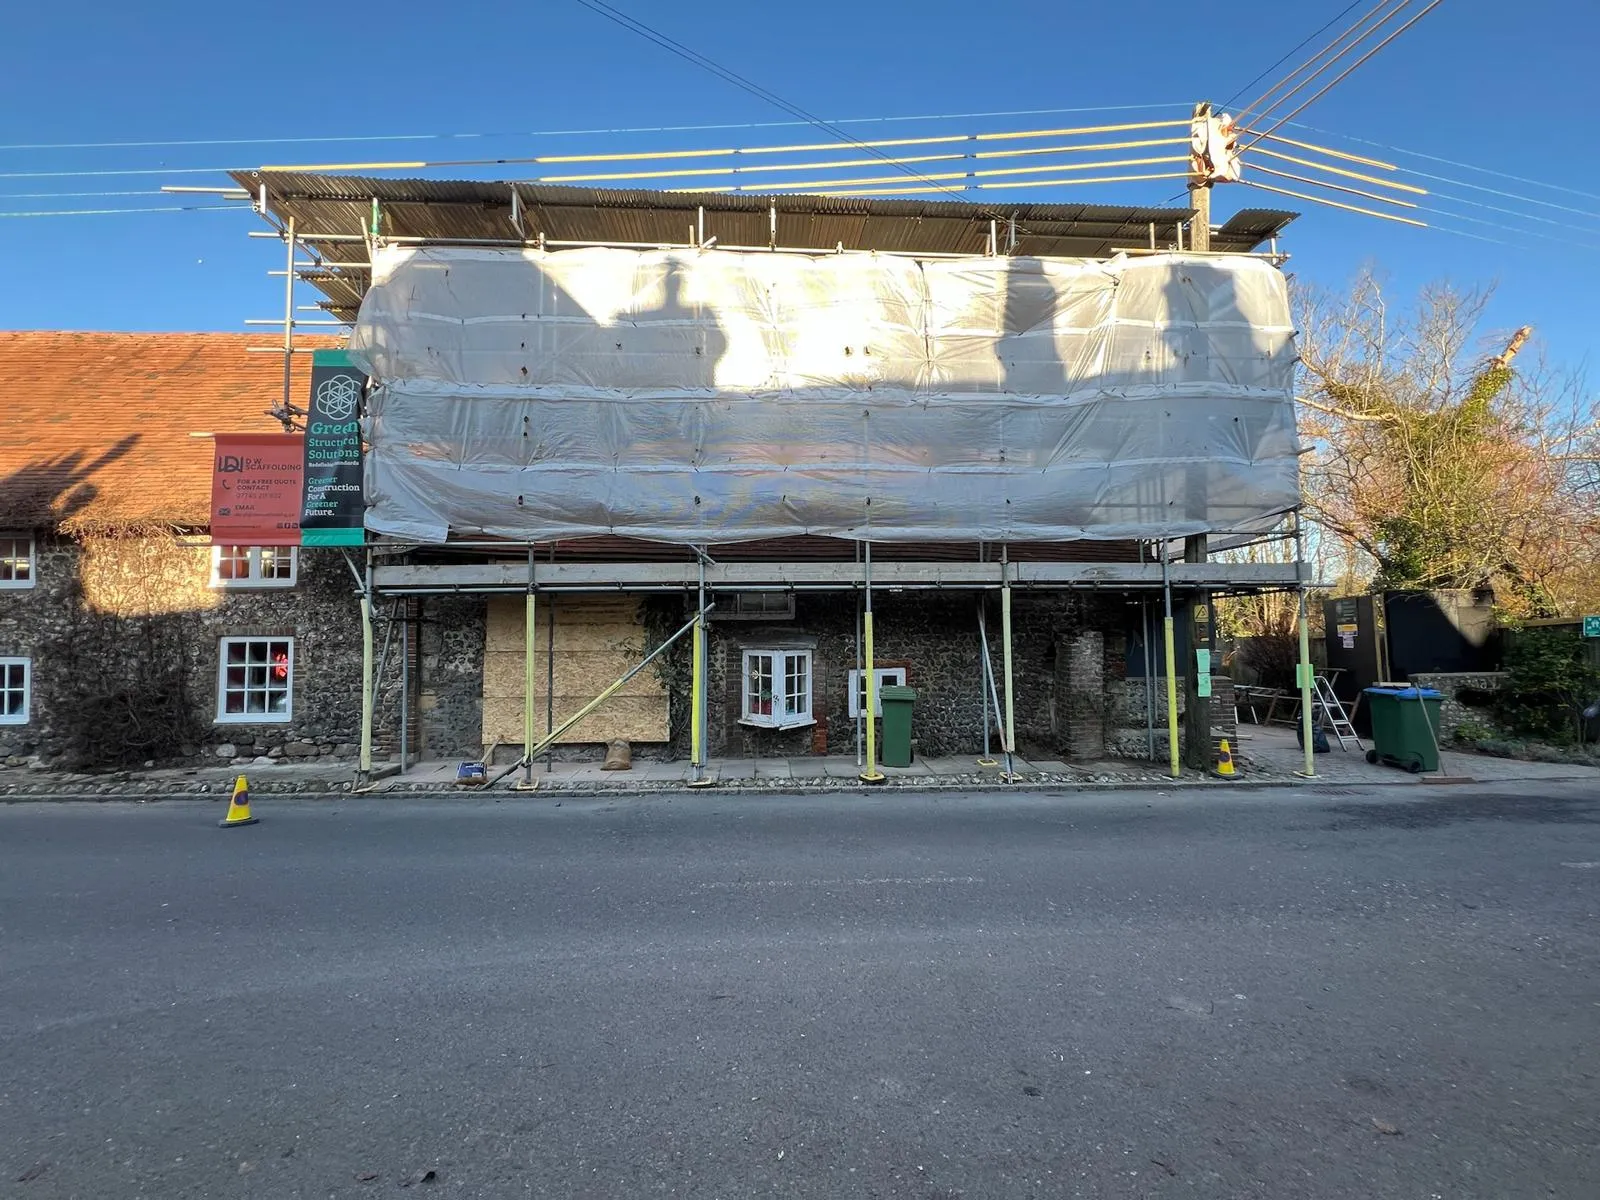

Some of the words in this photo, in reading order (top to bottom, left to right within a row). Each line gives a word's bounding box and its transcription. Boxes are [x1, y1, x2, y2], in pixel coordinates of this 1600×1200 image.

[311, 421, 359, 434] Green
[308, 449, 360, 459] Solutons
[307, 483, 360, 493] Construction
[307, 493, 319, 501] For
[319, 492, 326, 500] A
[304, 508, 335, 516] Future.
